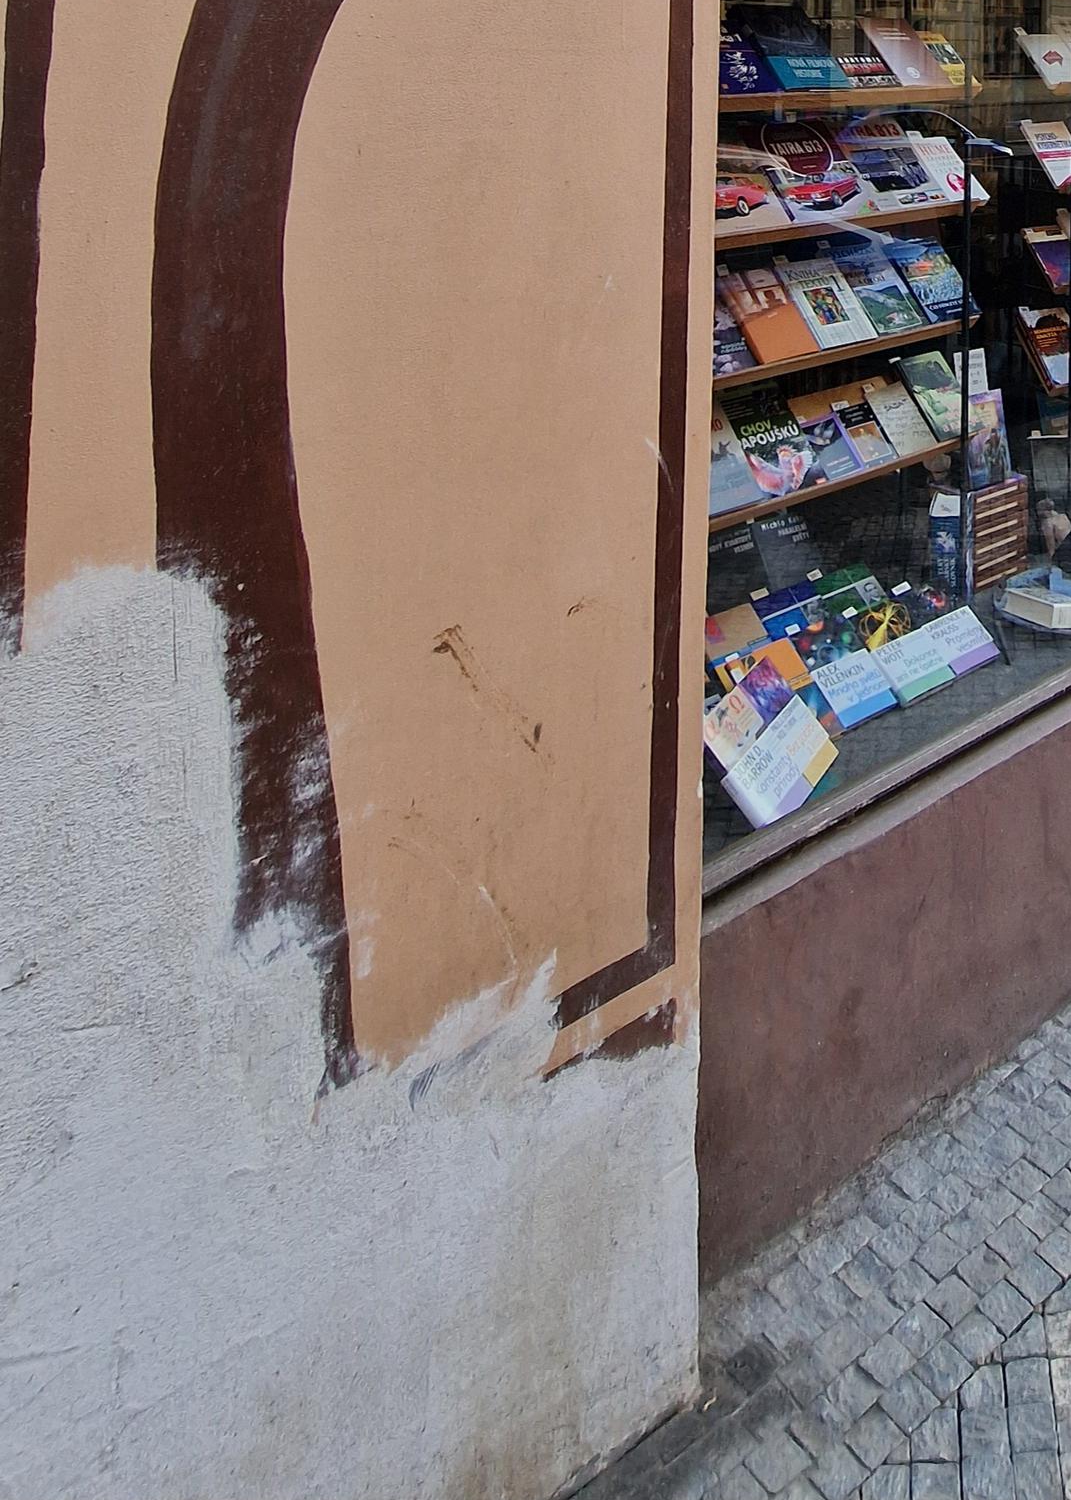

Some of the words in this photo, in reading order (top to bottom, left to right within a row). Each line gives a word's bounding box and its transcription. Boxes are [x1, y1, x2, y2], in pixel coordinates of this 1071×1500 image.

[769, 140, 802, 156] TATRA
[803, 138, 824, 153] 613
[740, 419, 772, 436] CHOV
[741, 420, 799, 450] APOUŠKŮ
[816, 662, 840, 680] ALEX
[820, 663, 864, 688] VILENKIN
[735, 751, 756, 780] JOHN
[742, 749, 775, 790] BARROW
